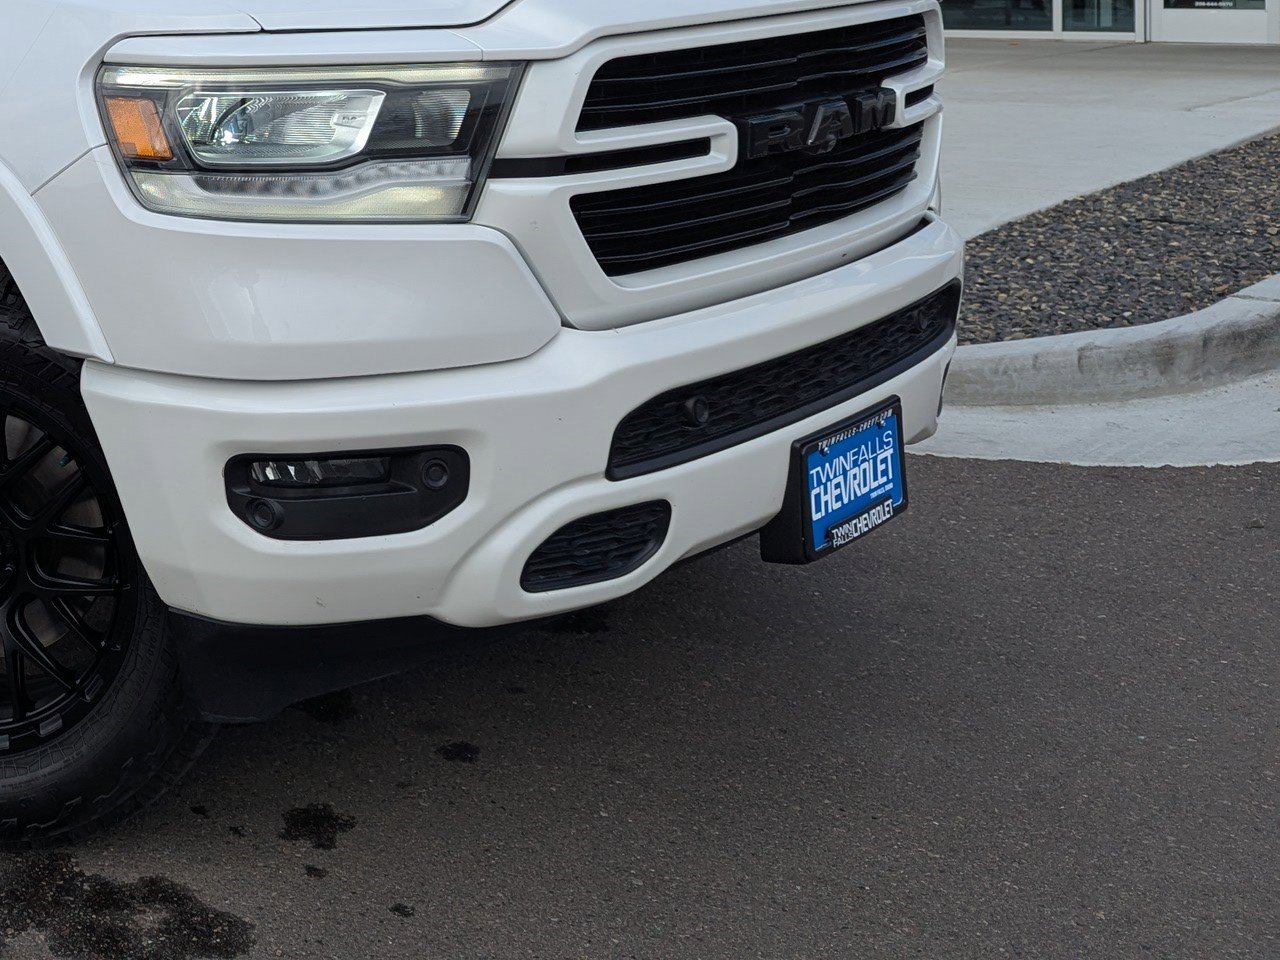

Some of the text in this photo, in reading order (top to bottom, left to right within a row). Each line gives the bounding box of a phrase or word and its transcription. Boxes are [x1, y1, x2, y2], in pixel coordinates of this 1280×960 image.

[746, 88, 896, 160] RAM
[809, 430, 894, 488] TWINFALLS
[811, 448, 894, 522] CHEVROLET
[831, 499, 894, 541] TWIN CHEVROLET
[832, 531, 854, 549] FALLS
